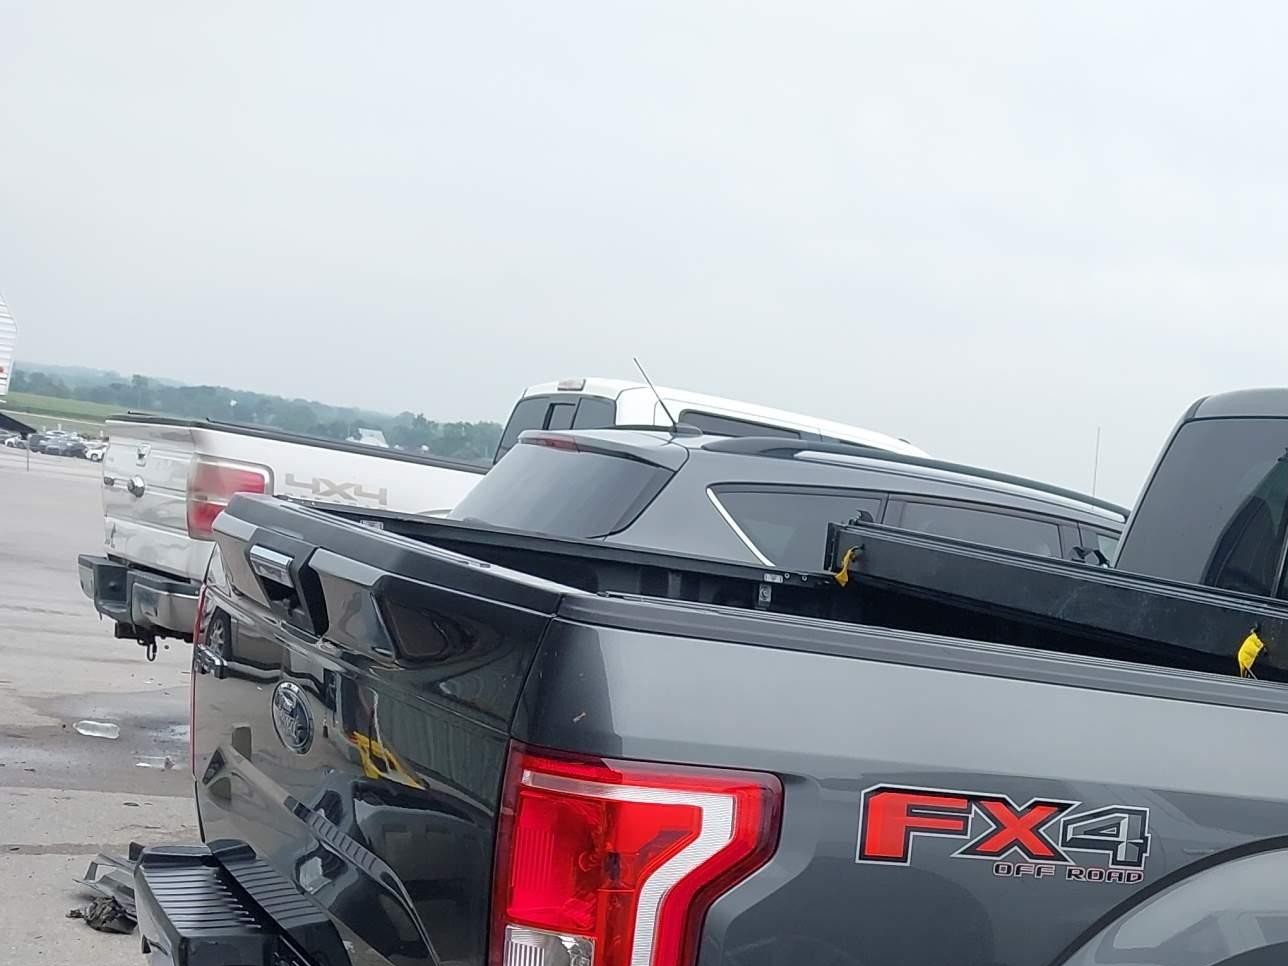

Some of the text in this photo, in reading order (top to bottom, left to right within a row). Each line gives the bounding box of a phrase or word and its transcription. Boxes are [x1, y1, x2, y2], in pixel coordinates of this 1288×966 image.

[856, 784, 1151, 869] FX4
[993, 862, 1145, 884] OFF ROAD
